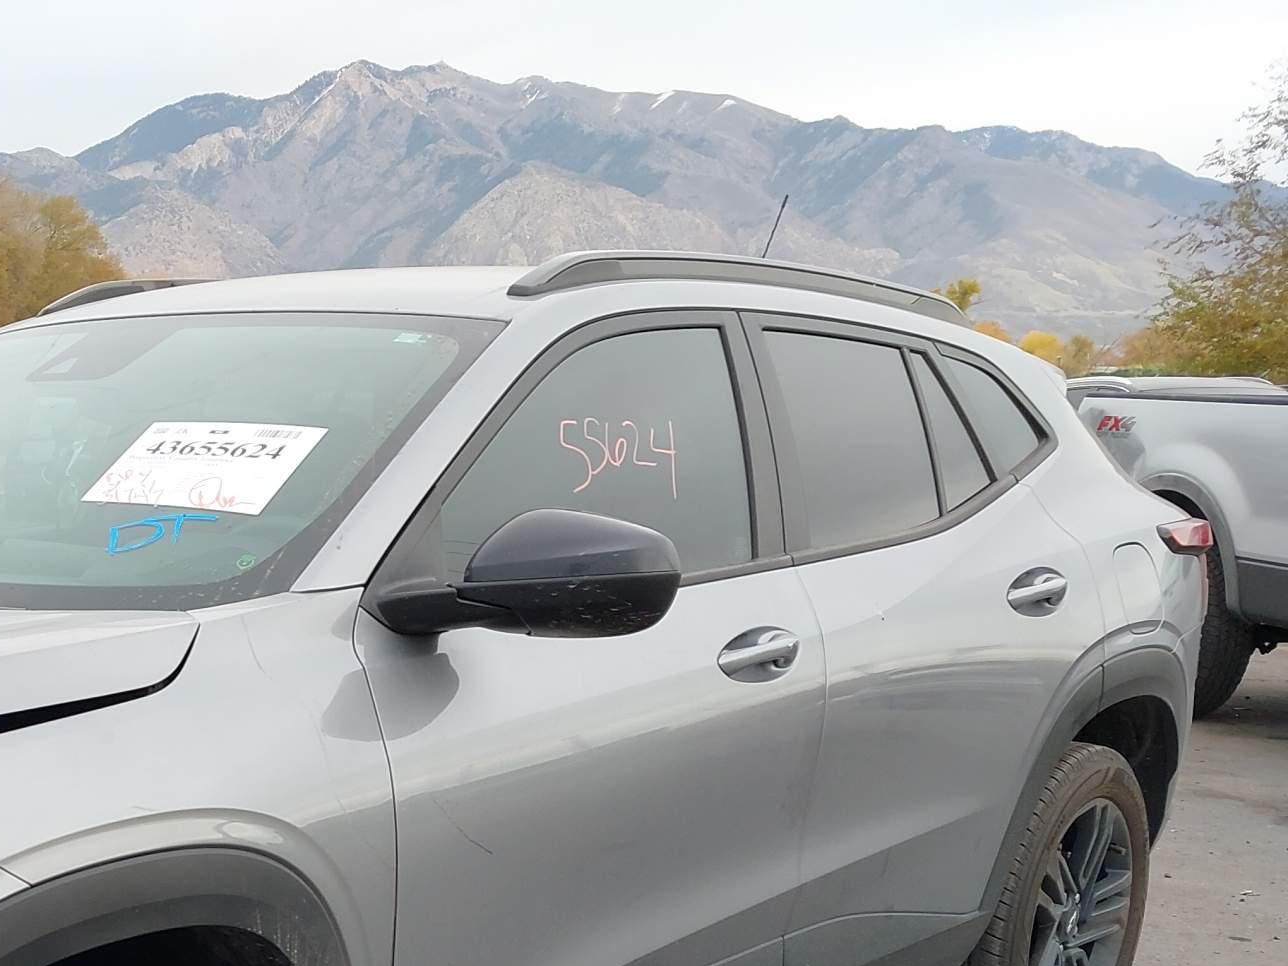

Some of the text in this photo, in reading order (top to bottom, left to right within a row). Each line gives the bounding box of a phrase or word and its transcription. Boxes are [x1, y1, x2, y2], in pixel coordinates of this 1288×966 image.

[1095, 415, 1137, 432] FX4
[146, 440, 288, 461] 43655624
[560, 417, 678, 500] 55624
[105, 512, 221, 556] DT
